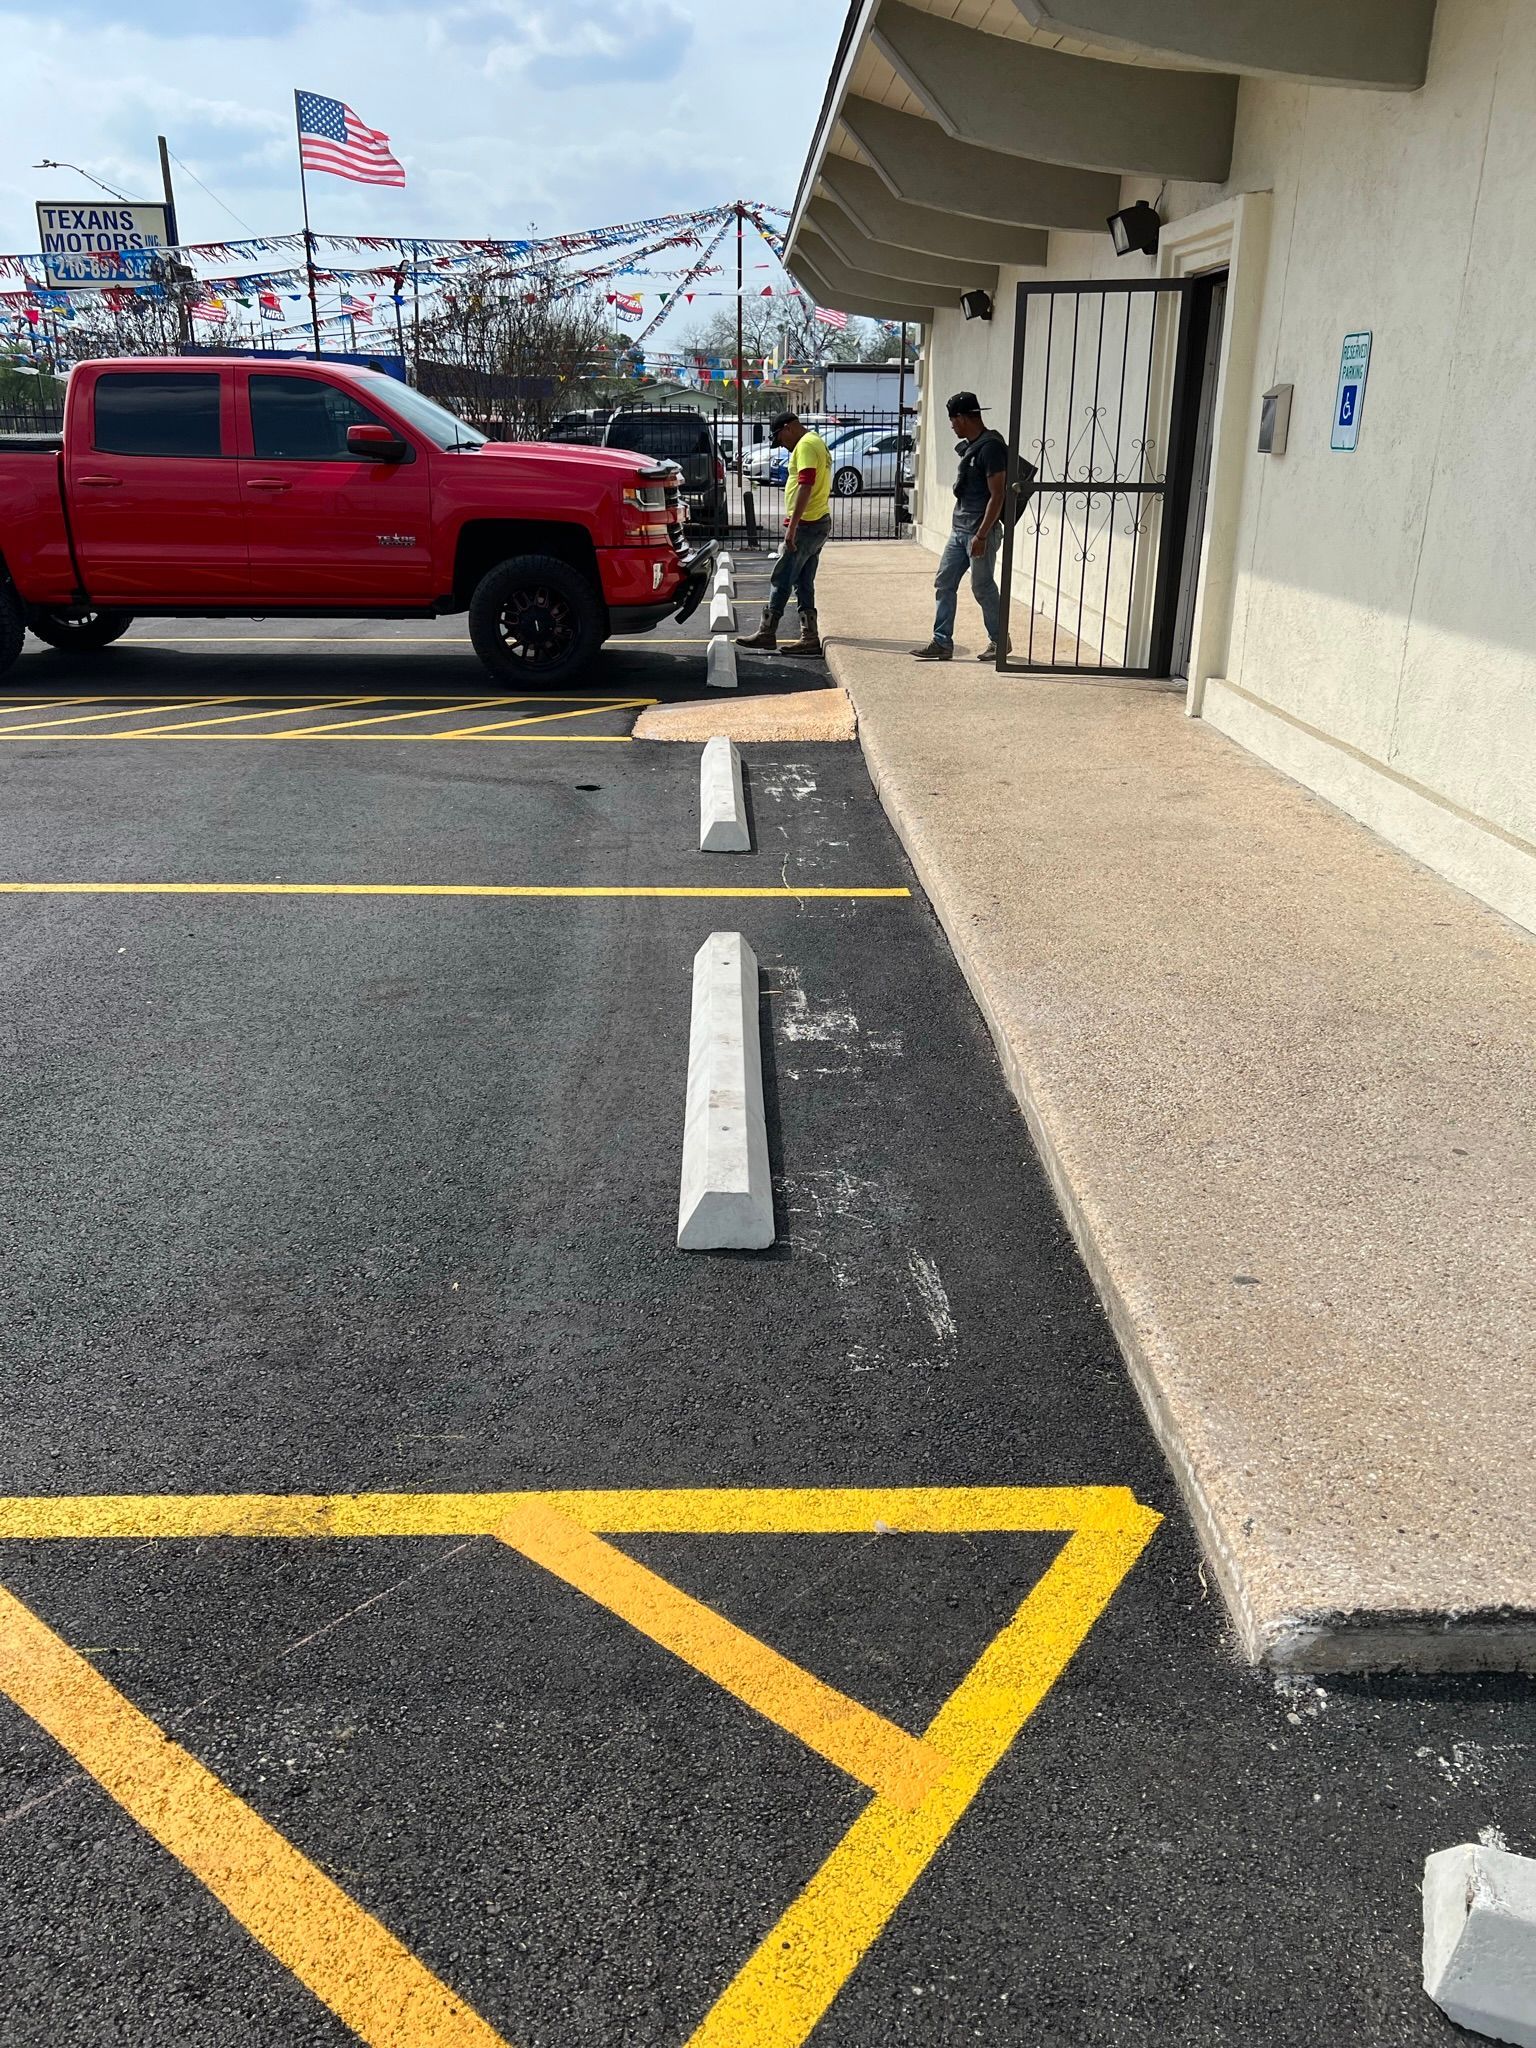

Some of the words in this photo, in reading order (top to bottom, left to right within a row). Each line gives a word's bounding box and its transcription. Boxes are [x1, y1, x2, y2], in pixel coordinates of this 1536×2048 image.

[43, 210, 134, 230] TEXANS
[45, 232, 143, 253] MOTORS
[1343, 343, 1368, 360] RESERVED
[1342, 364, 1364, 380] PARKING
